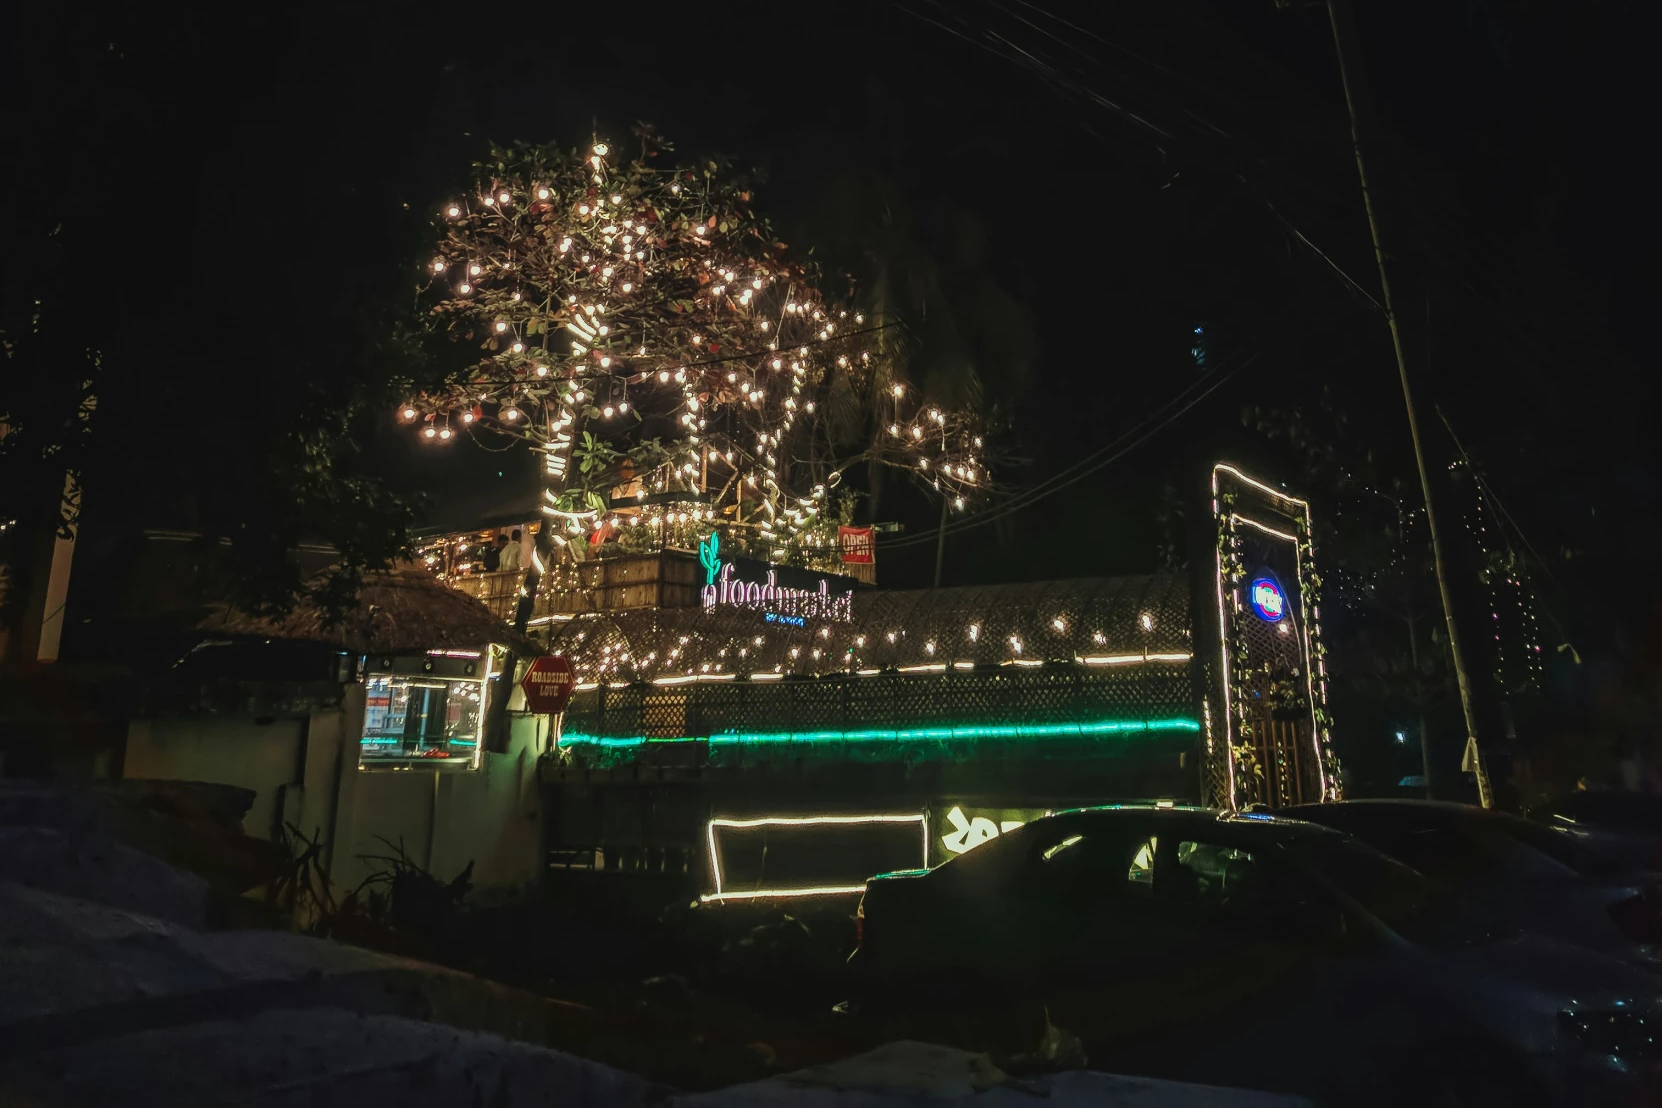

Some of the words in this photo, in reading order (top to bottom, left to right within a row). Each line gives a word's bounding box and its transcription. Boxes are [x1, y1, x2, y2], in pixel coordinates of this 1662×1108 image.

[843, 533, 870, 556] OPEN
[531, 671, 569, 684] ROADSIDE
[540, 685, 559, 697] LOVE
